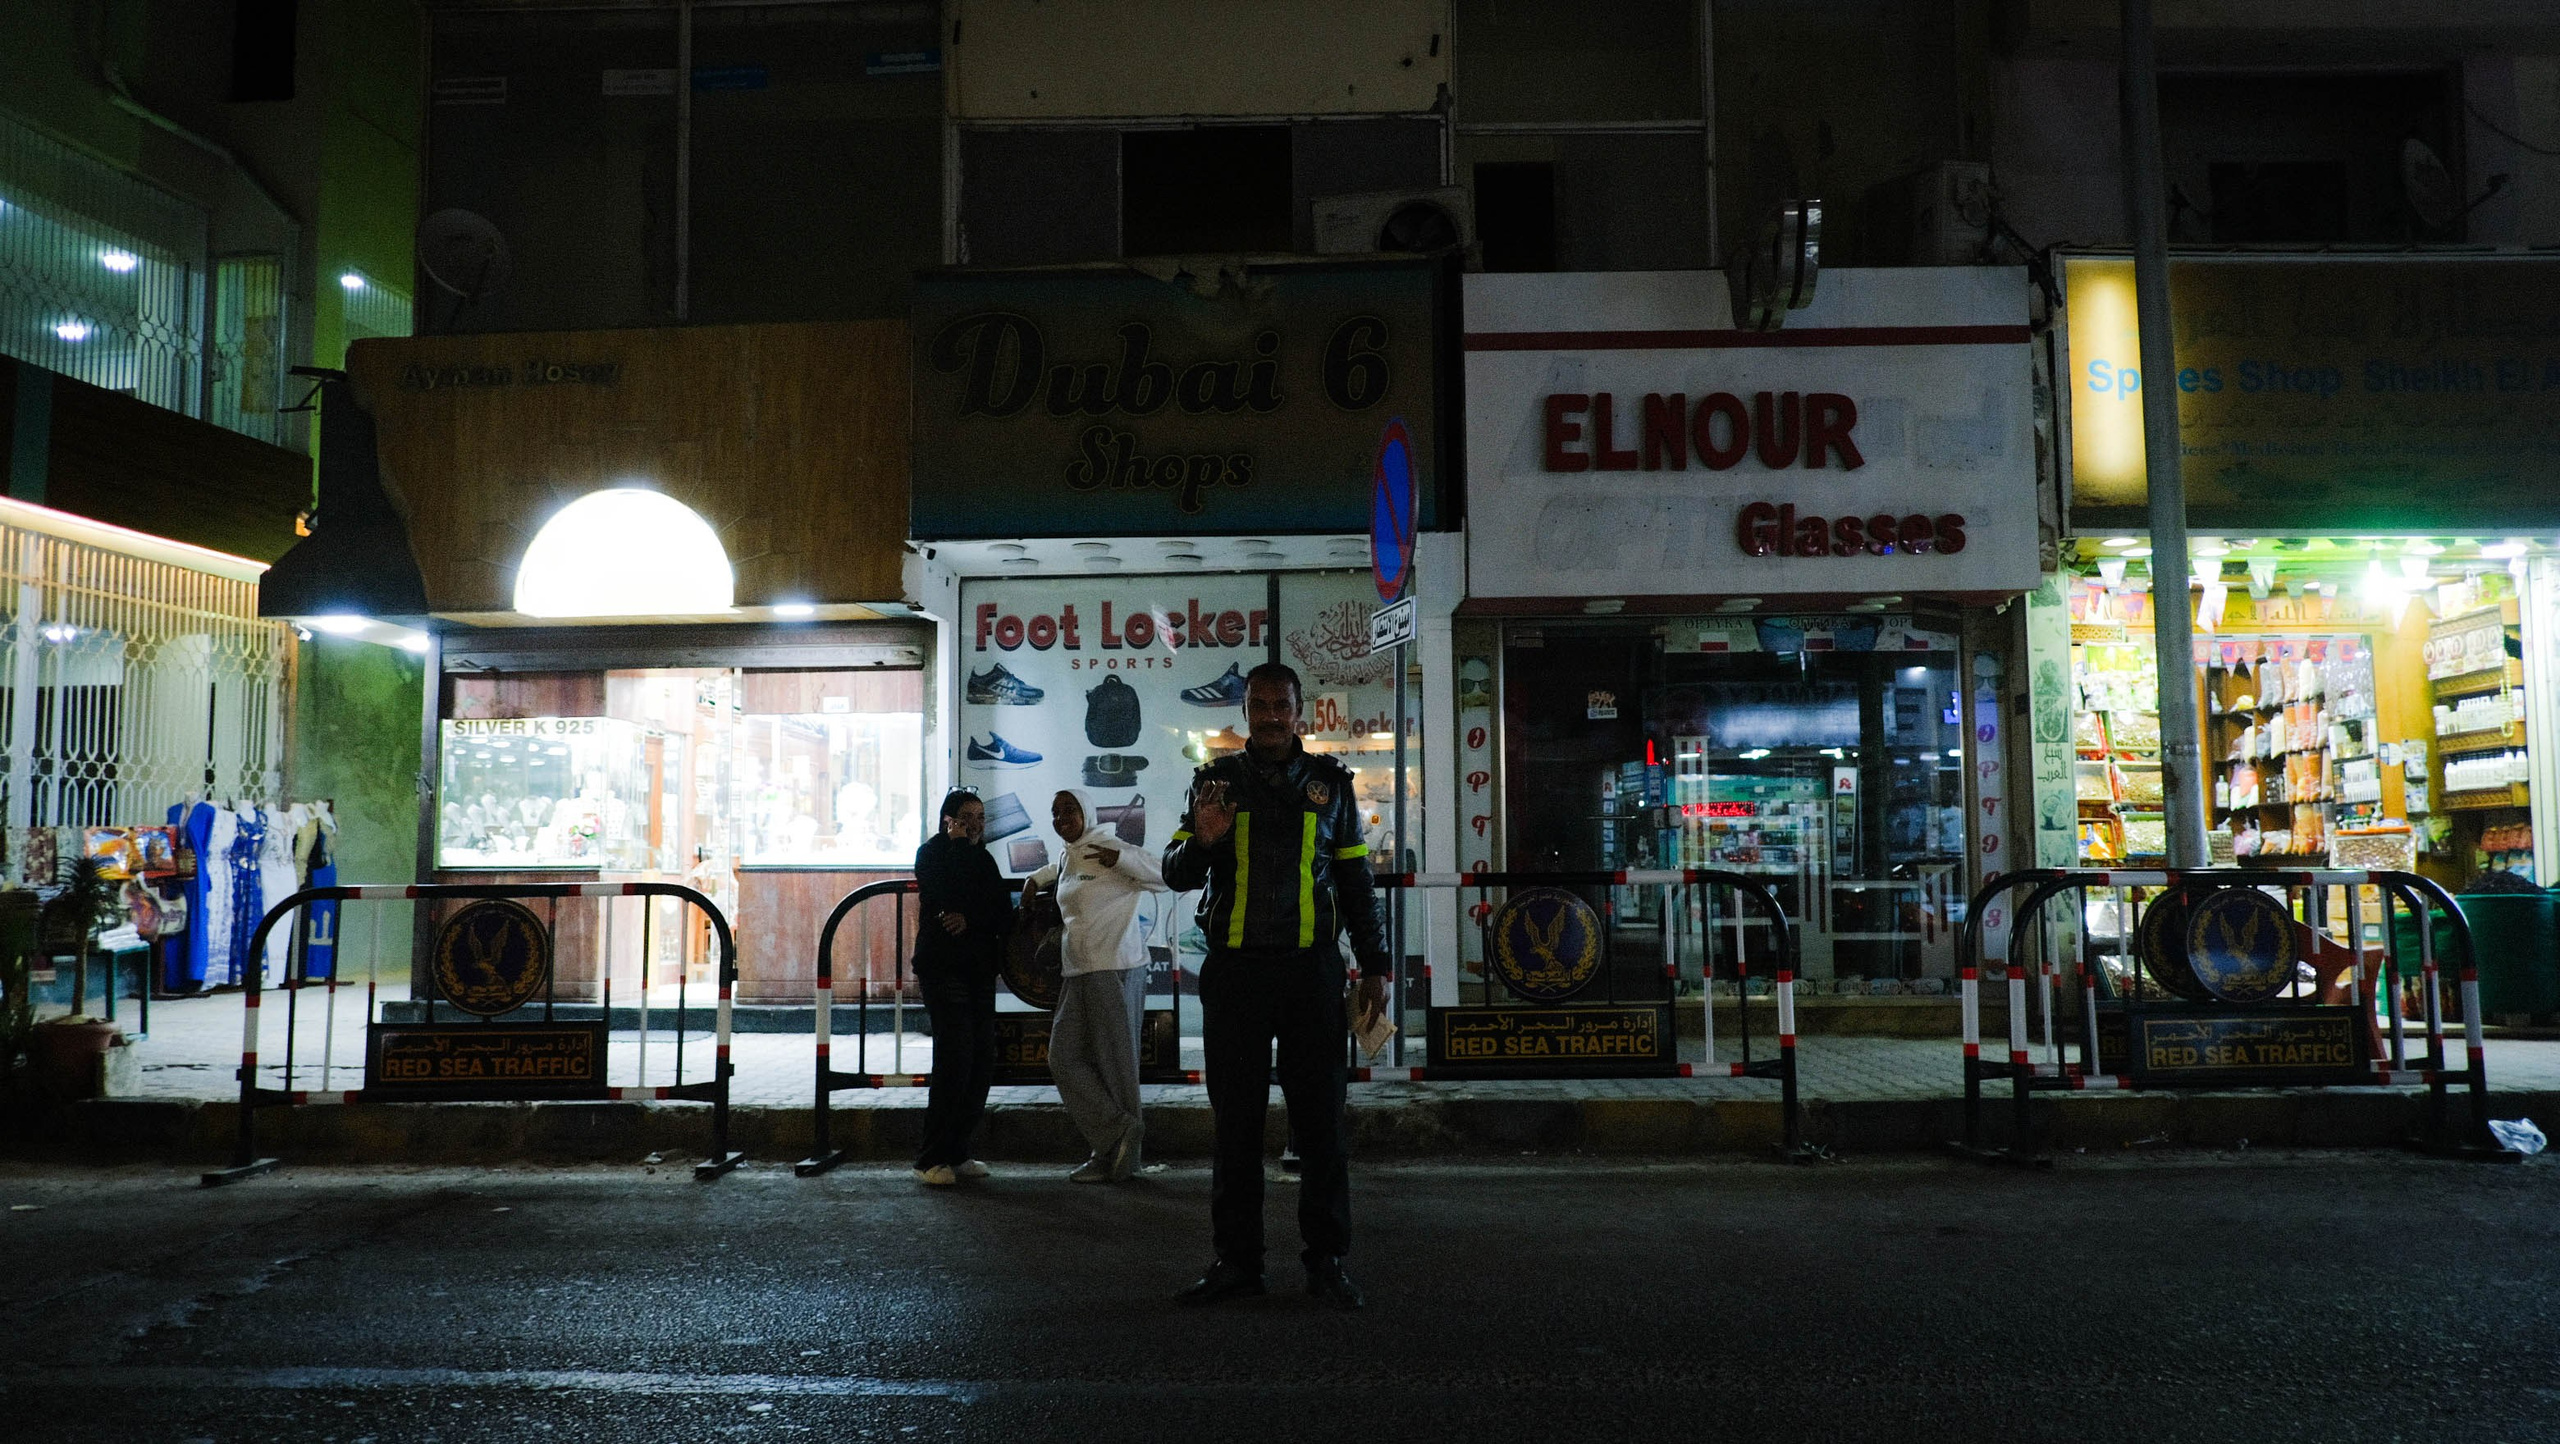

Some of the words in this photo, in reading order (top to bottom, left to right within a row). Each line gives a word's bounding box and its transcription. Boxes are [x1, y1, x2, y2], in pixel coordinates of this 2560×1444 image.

[930, 312, 1284, 417] Dubai
[1323, 315, 1390, 411] 6
[2087, 359, 2223, 400] Spes
[2238, 357, 2342, 399] Shop
[2363, 356, 2484, 394] Sheikh
[1544, 391, 1865, 473] ELNOUR
[1065, 425, 1255, 514] Shops
[1737, 502, 1967, 557] Glasses
[976, 602, 1080, 651] Foot
[1101, 598, 1269, 649] Locker
[1685, 617, 1744, 629] OPTYKA
[1071, 656, 1173, 670] SPORTS
[1315, 698, 1348, 732] 50%
[454, 720, 526, 735] SILVER
[534, 720, 546, 734] K
[556, 720, 595, 734] 925
[1517, 1016, 1574, 1034] البحر
[1578, 1018, 1618, 1034] مرور
[1451, 1037, 1497, 1056] RED
[1504, 1036, 1550, 1055] SEA
[1556, 1034, 1652, 1054] TRAFFIC
[2152, 1046, 2197, 1066] RED
[2205, 1045, 2250, 1066] SEA
[2256, 1043, 2347, 1064] TRAFFIC
[386, 1057, 432, 1077] RED
[440, 1057, 484, 1076] SEA
[491, 1055, 586, 1075] TRAFFIC
